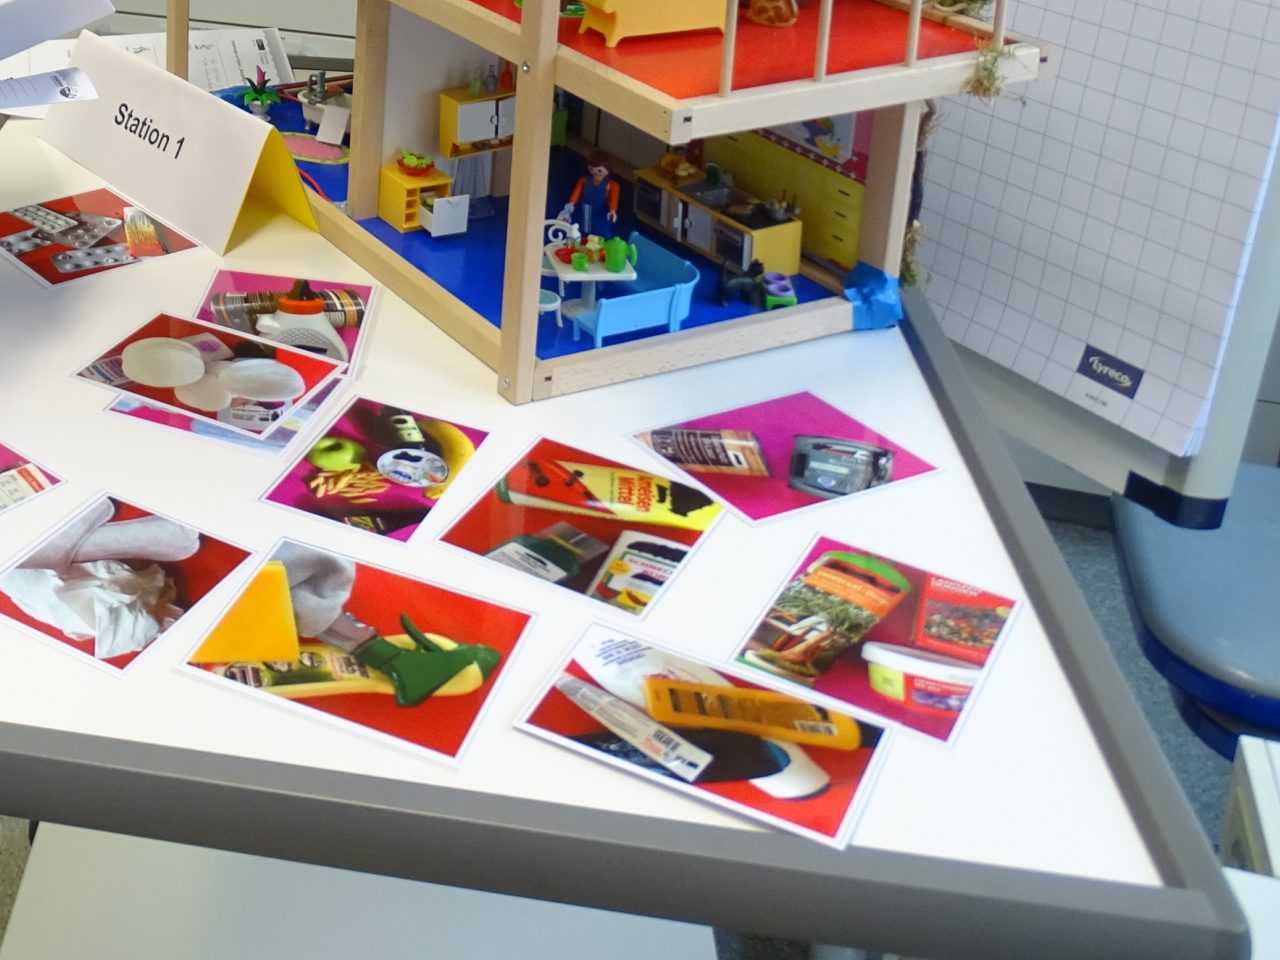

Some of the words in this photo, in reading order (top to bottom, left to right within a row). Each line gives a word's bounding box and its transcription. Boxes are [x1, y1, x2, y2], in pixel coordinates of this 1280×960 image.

[114, 102, 170, 152] Station
[174, 136, 186, 160] 1
[1090, 356, 1131, 386] Lyreco
